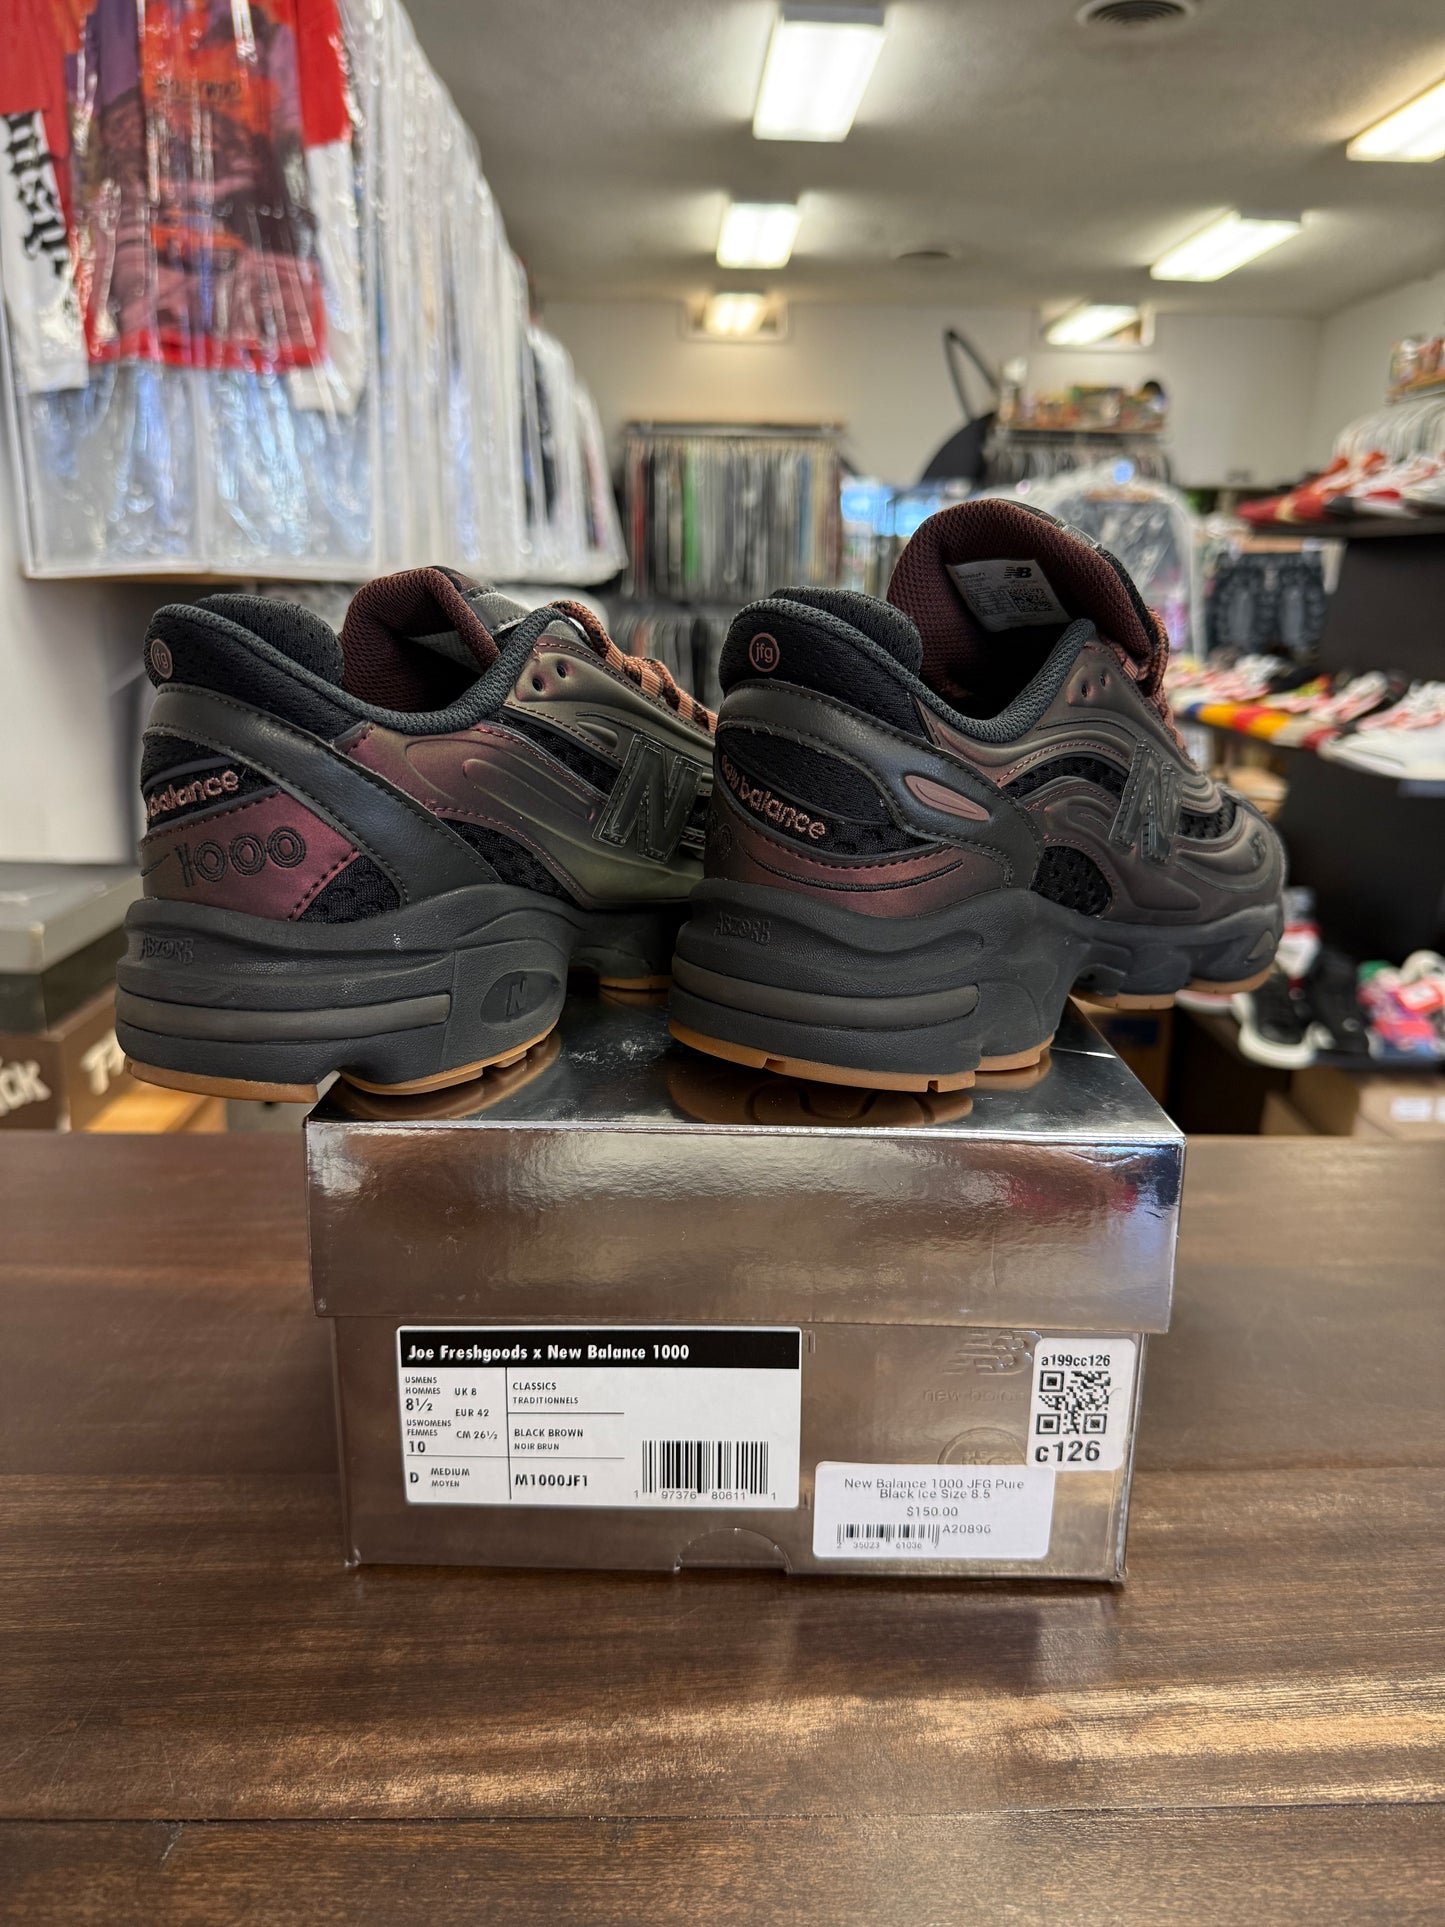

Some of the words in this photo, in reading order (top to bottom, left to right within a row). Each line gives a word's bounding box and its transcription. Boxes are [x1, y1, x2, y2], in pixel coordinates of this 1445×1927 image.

[756, 642, 773, 663] jfg
[738, 774, 826, 840] balance
[174, 825, 307, 888] 1000
[408, 1344, 435, 1361] Joe
[440, 1344, 528, 1364] Freshgoods
[533, 1348, 542, 1360] x
[547, 1345, 582, 1360] New
[587, 1344, 646, 1360] Balance
[652, 1345, 690, 1360] 1000
[1040, 1354, 1111, 1367] a199cc126
[405, 1376, 438, 1384] USMENS
[405, 1387, 441, 1395] HOMMES
[454, 1387, 468, 1396] UK
[471, 1387, 477, 1396] 8
[512, 1381, 557, 1391] CLASSICS
[512, 1396, 579, 1405] TRADITIONNELS
[455, 1408, 474, 1417] EUR
[477, 1408, 490, 1417] 42
[406, 1419, 452, 1427] USWOMENS
[407, 1428, 439, 1437] FEMMES
[456, 1430, 471, 1439] CM
[513, 1428, 546, 1438] BLACK
[548, 1428, 584, 1438] BROWN
[409, 1440, 426, 1453] 10
[513, 1442, 536, 1450] NOIR
[537, 1442, 560, 1450] BRUN
[1034, 1440, 1102, 1463] c126
[409, 1471, 420, 1483] D
[430, 1467, 470, 1477] MEDIUM
[514, 1473, 589, 1488] M1000JF1
[844, 1478, 873, 1489] New
[876, 1478, 927, 1489] Balance
[931, 1478, 963, 1489] 1000
[966, 1478, 992, 1489] JFG
[661, 1490, 697, 1501] 97376
[711, 1491, 747, 1501] 80611
[879, 1488, 915, 1499] Black
[917, 1489, 937, 1499] Ice
[940, 1489, 968, 1499] Size
[970, 1489, 991, 1499] 8.5
[906, 1505, 959, 1518] $150.00
[942, 1524, 992, 1535] A20896
